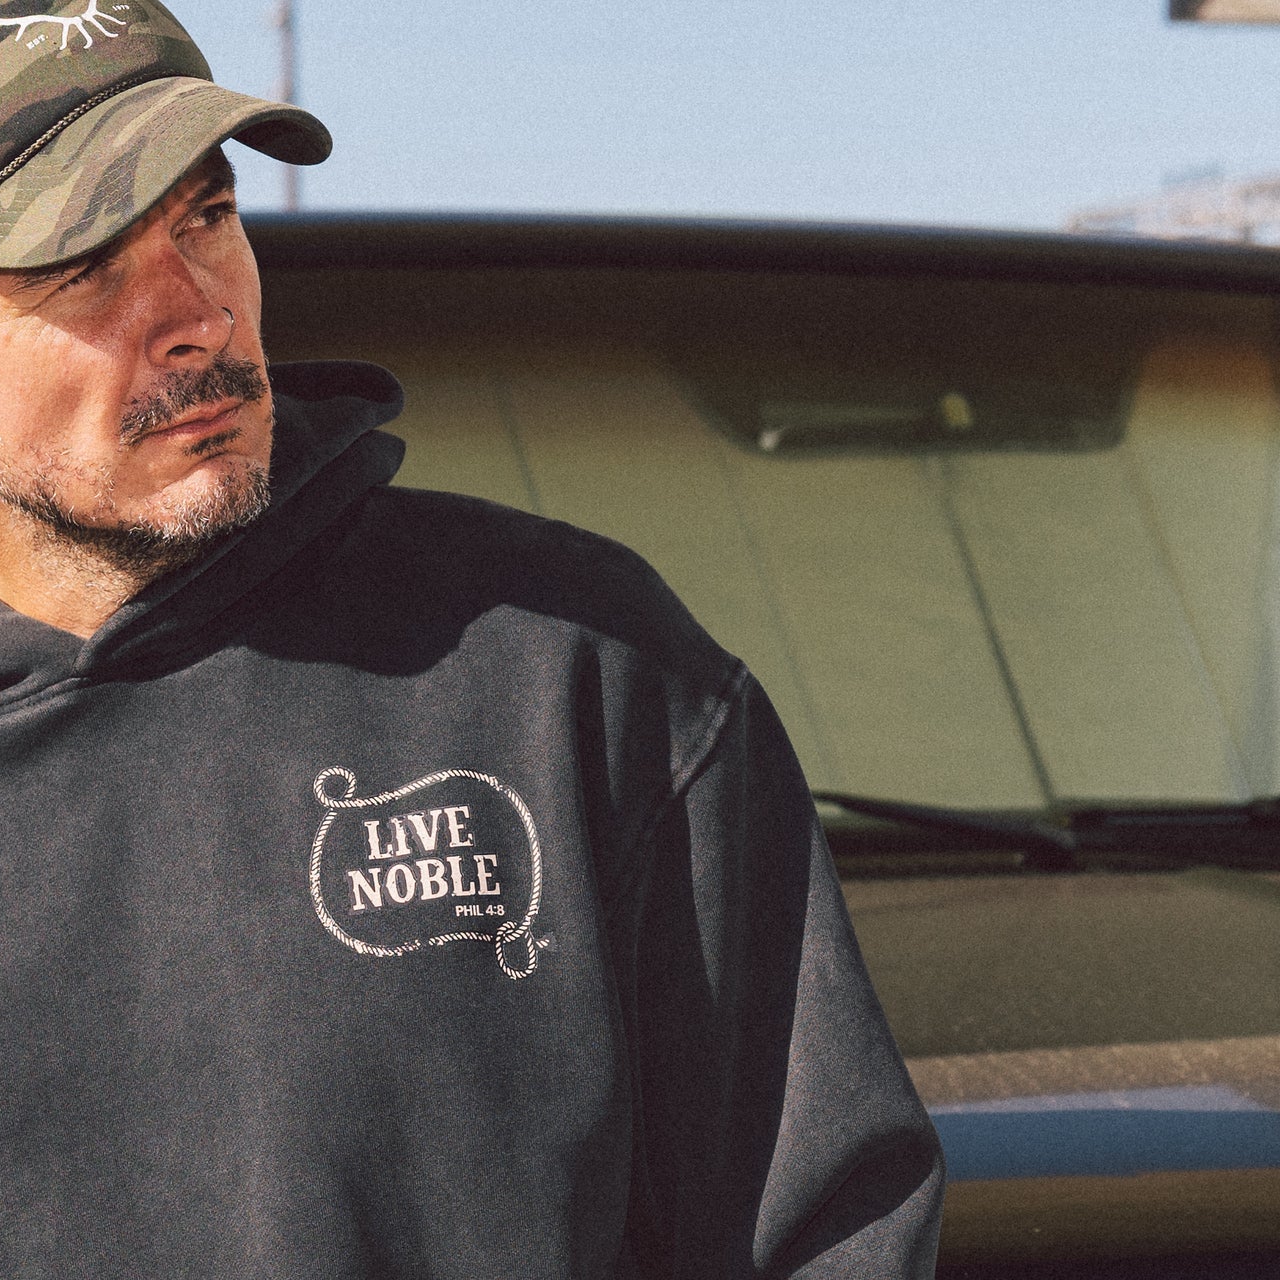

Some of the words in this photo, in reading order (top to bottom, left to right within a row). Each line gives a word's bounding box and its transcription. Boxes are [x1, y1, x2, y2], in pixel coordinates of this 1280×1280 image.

[364, 805, 473, 860] LIVE
[348, 854, 501, 911] NOBLE
[455, 904, 484, 917] PHIL
[485, 904, 505, 916] 4:8
